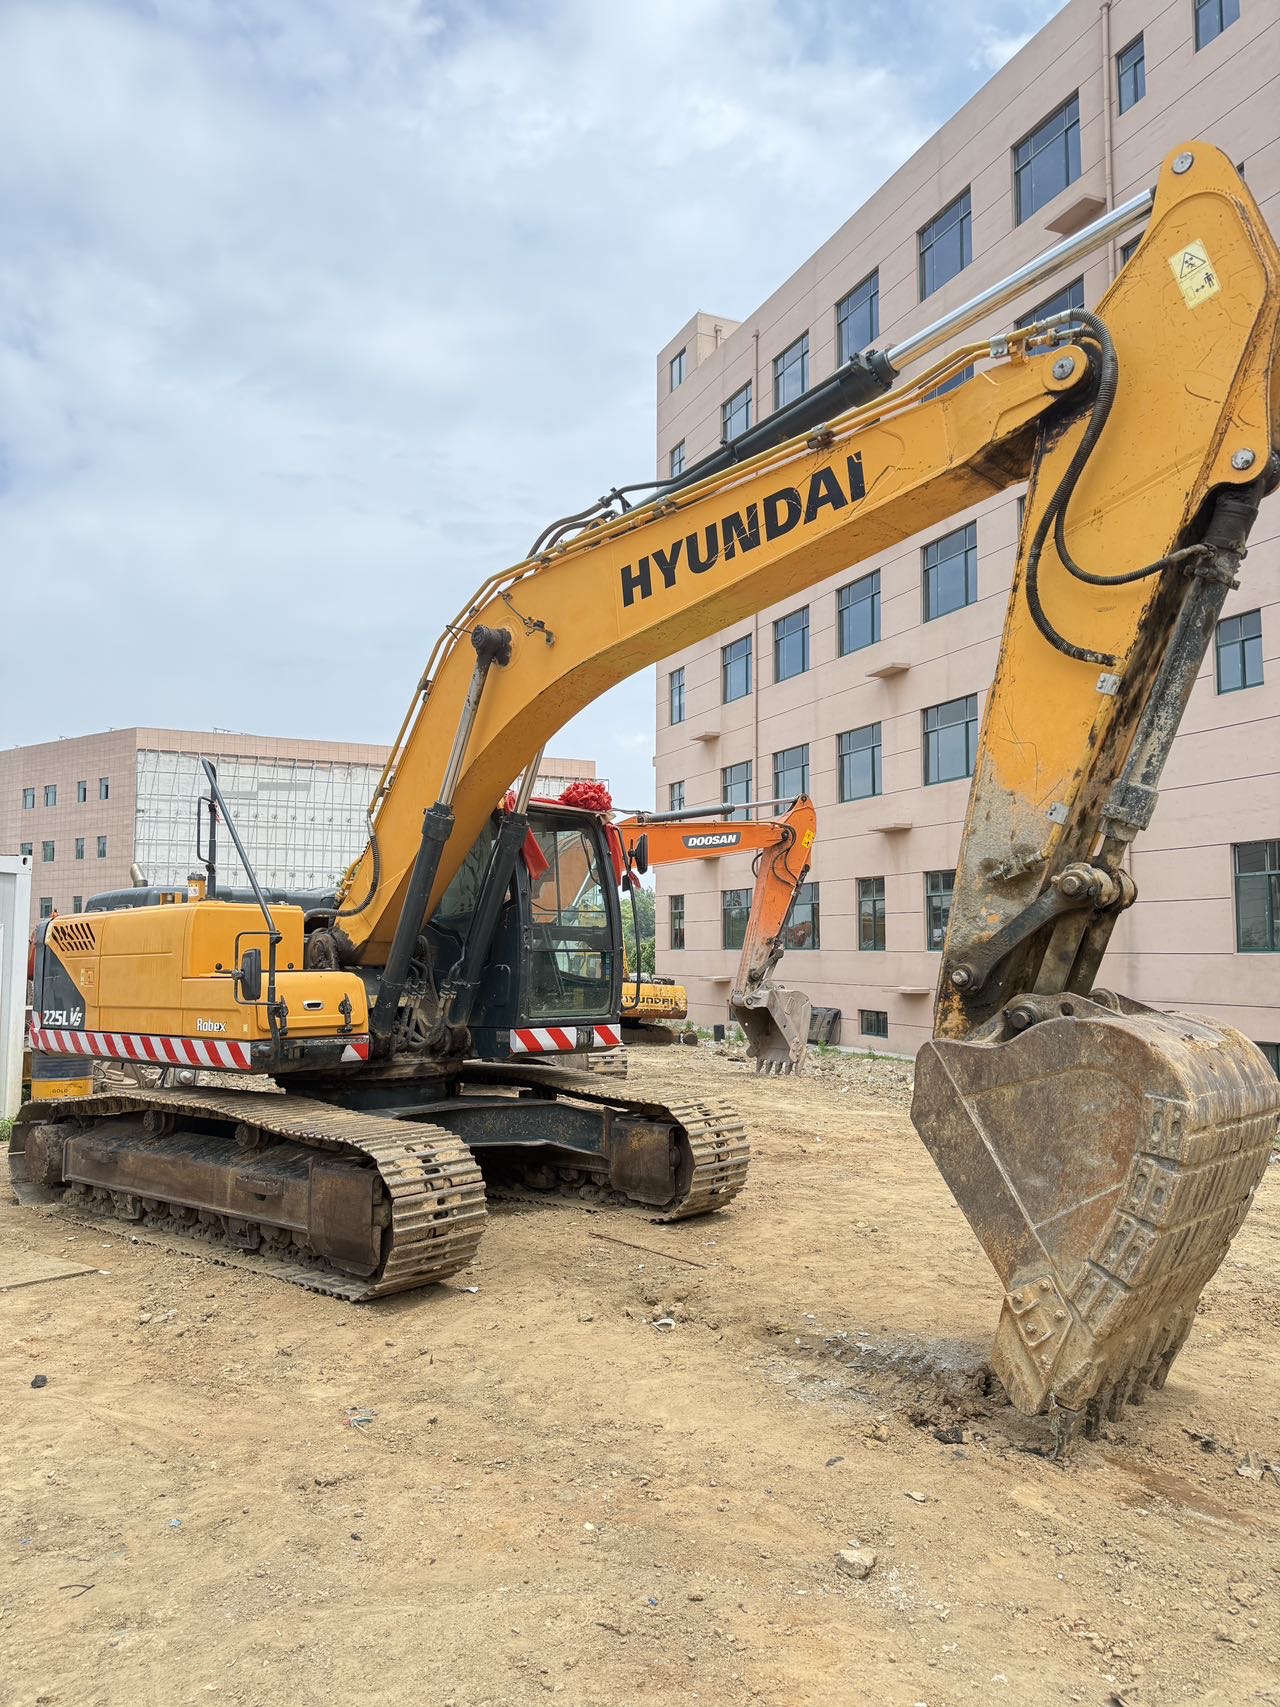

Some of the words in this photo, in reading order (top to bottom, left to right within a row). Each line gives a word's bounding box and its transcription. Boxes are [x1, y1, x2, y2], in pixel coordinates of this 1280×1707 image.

[620, 451, 866, 608] HYUNDAI
[687, 834, 737, 847] DOOSAN
[196, 1018, 227, 1032] Robex
